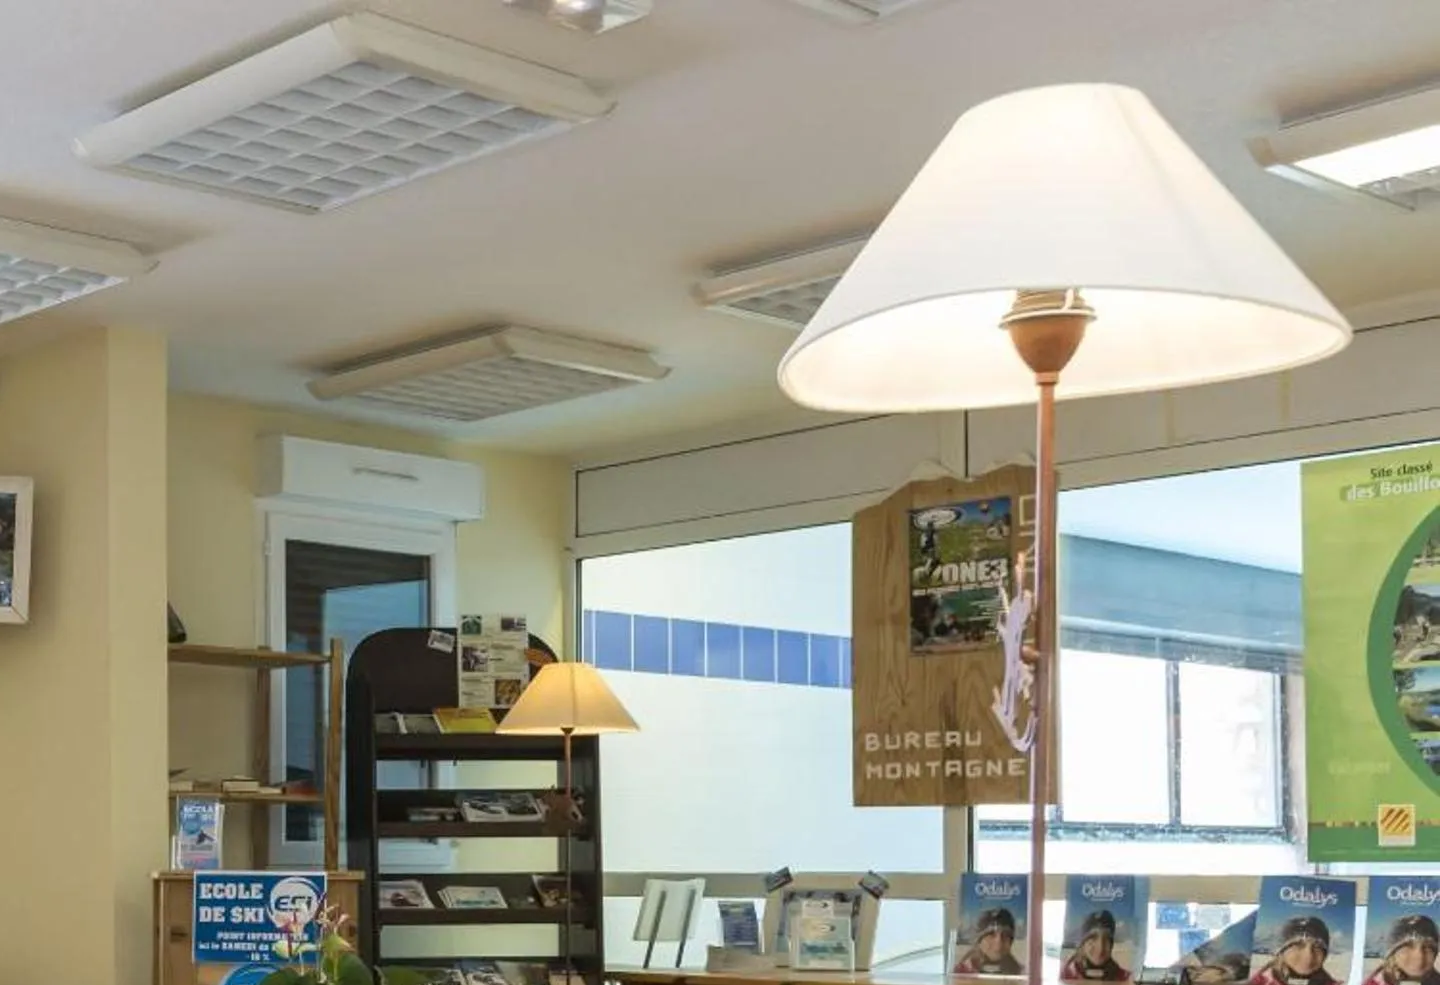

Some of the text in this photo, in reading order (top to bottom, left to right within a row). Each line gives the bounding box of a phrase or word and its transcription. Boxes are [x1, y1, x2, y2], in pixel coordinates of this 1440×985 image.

[1370, 460, 1433, 478] Site classé
[1347, 483, 1377, 501] des
[864, 730, 983, 751] BUREAU
[865, 758, 1027, 780] MONTAGNE
[199, 882, 264, 900] ECOLE
[975, 881, 1021, 899] Odalys
[1082, 881, 1125, 899] Odalys
[1279, 884, 1338, 909] Odalys
[199, 905, 266, 923] DE SKI
[216, 931, 245, 941] POINT
[221, 941, 257, 952] SAMEDI
